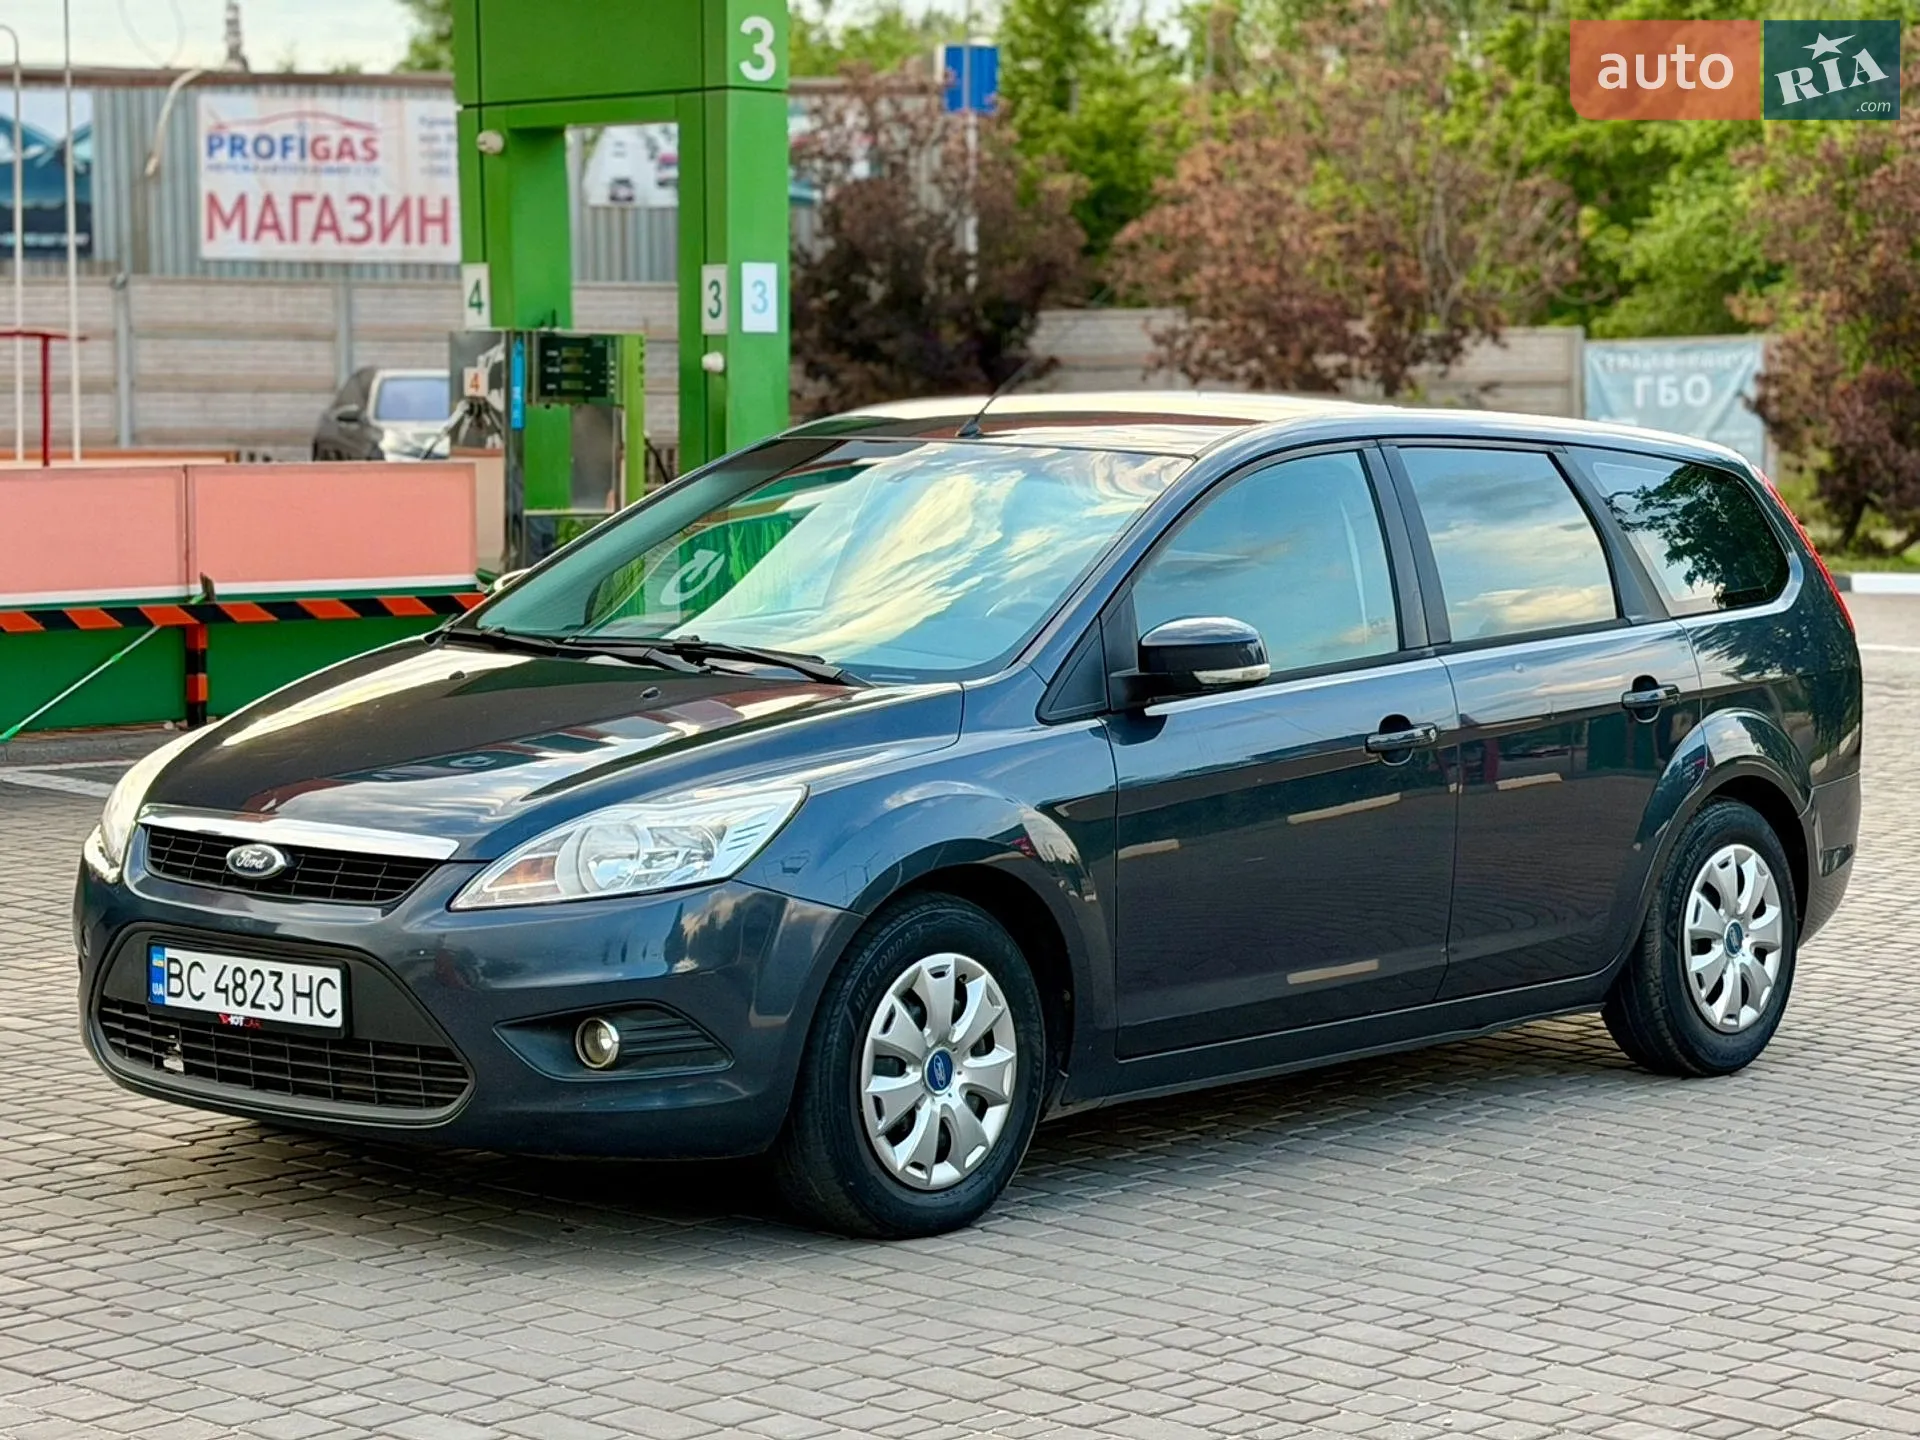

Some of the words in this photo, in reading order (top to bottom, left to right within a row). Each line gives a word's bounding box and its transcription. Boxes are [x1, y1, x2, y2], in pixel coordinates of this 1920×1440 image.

[739, 16, 777, 81] 3
[206, 132, 380, 163] PROFIGAS
[206, 191, 452, 245] МАГАЗИН
[468, 279, 484, 316] 4
[707, 279, 722, 319] 3
[751, 280, 769, 314] 3
[469, 372, 481, 393] 4
[1634, 374, 1712, 409] ГБО
[236, 850, 268, 869] Ford
[152, 982, 164, 996] UA
[166, 957, 206, 1002] BC
[214, 964, 283, 1012] 4823
[292, 973, 338, 1019] HC
